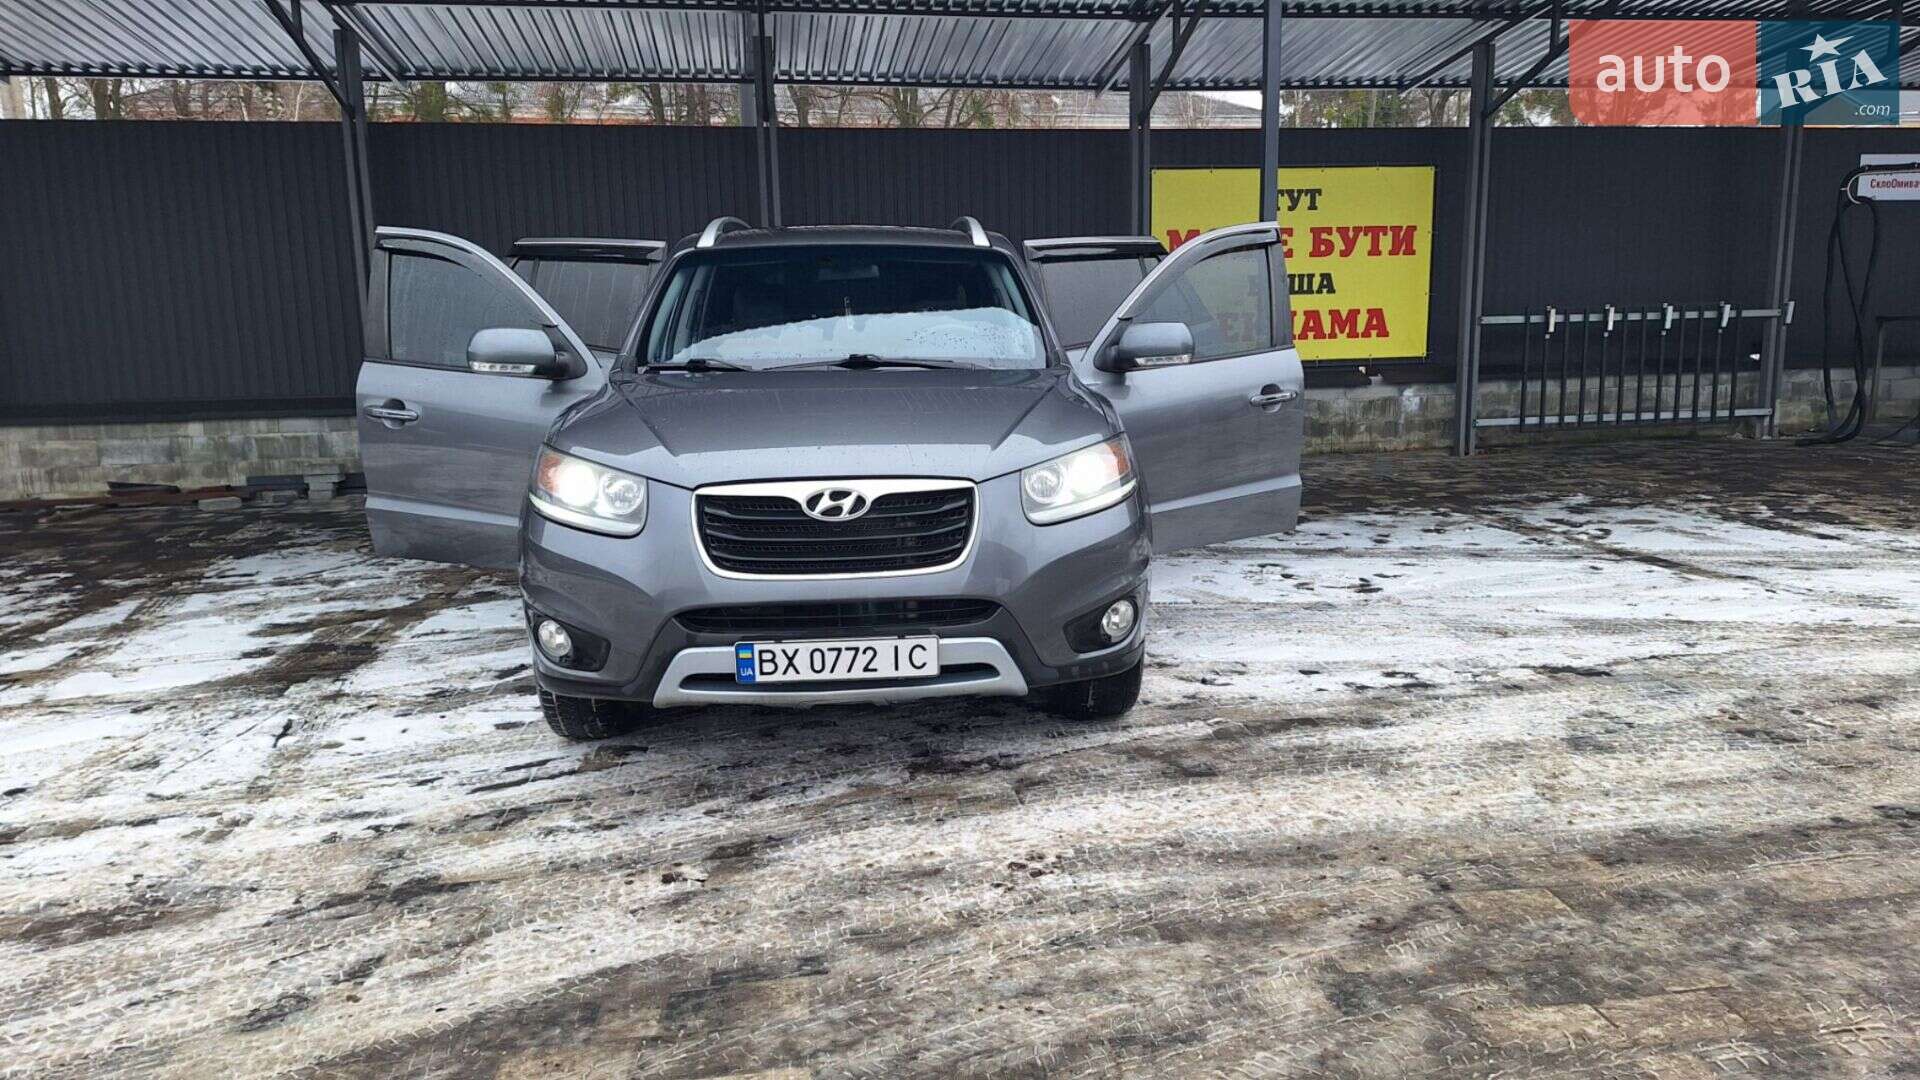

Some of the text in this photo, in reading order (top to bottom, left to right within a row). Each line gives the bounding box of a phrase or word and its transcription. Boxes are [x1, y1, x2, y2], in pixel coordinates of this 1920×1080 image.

[1308, 225, 1417, 258] БУТИ
[1287, 273, 1336, 295] ША
[740, 667, 754, 677] UA
[758, 644, 928, 676] BX 0772 IC
